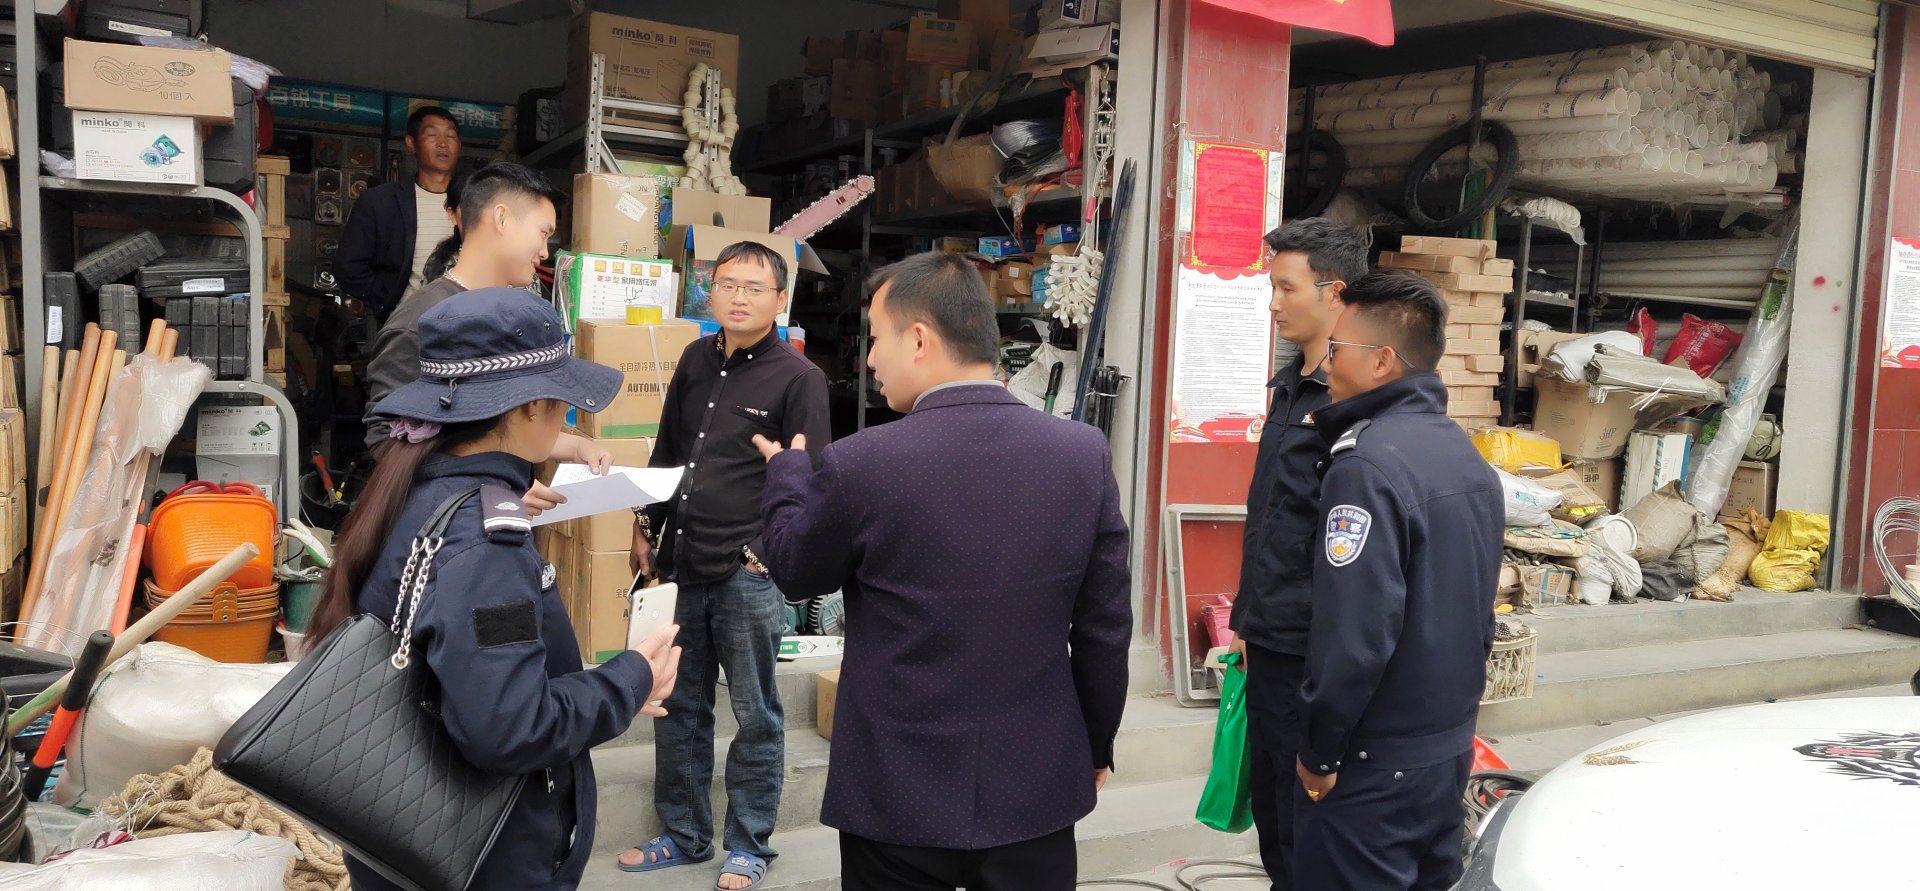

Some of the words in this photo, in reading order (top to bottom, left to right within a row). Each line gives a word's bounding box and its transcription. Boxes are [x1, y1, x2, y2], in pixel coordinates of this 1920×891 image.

[612, 26, 650, 40] minko
[269, 85, 352, 113] 百锐工具
[81, 117, 120, 128] minko
[1600, 427, 1617, 440] 3HP
